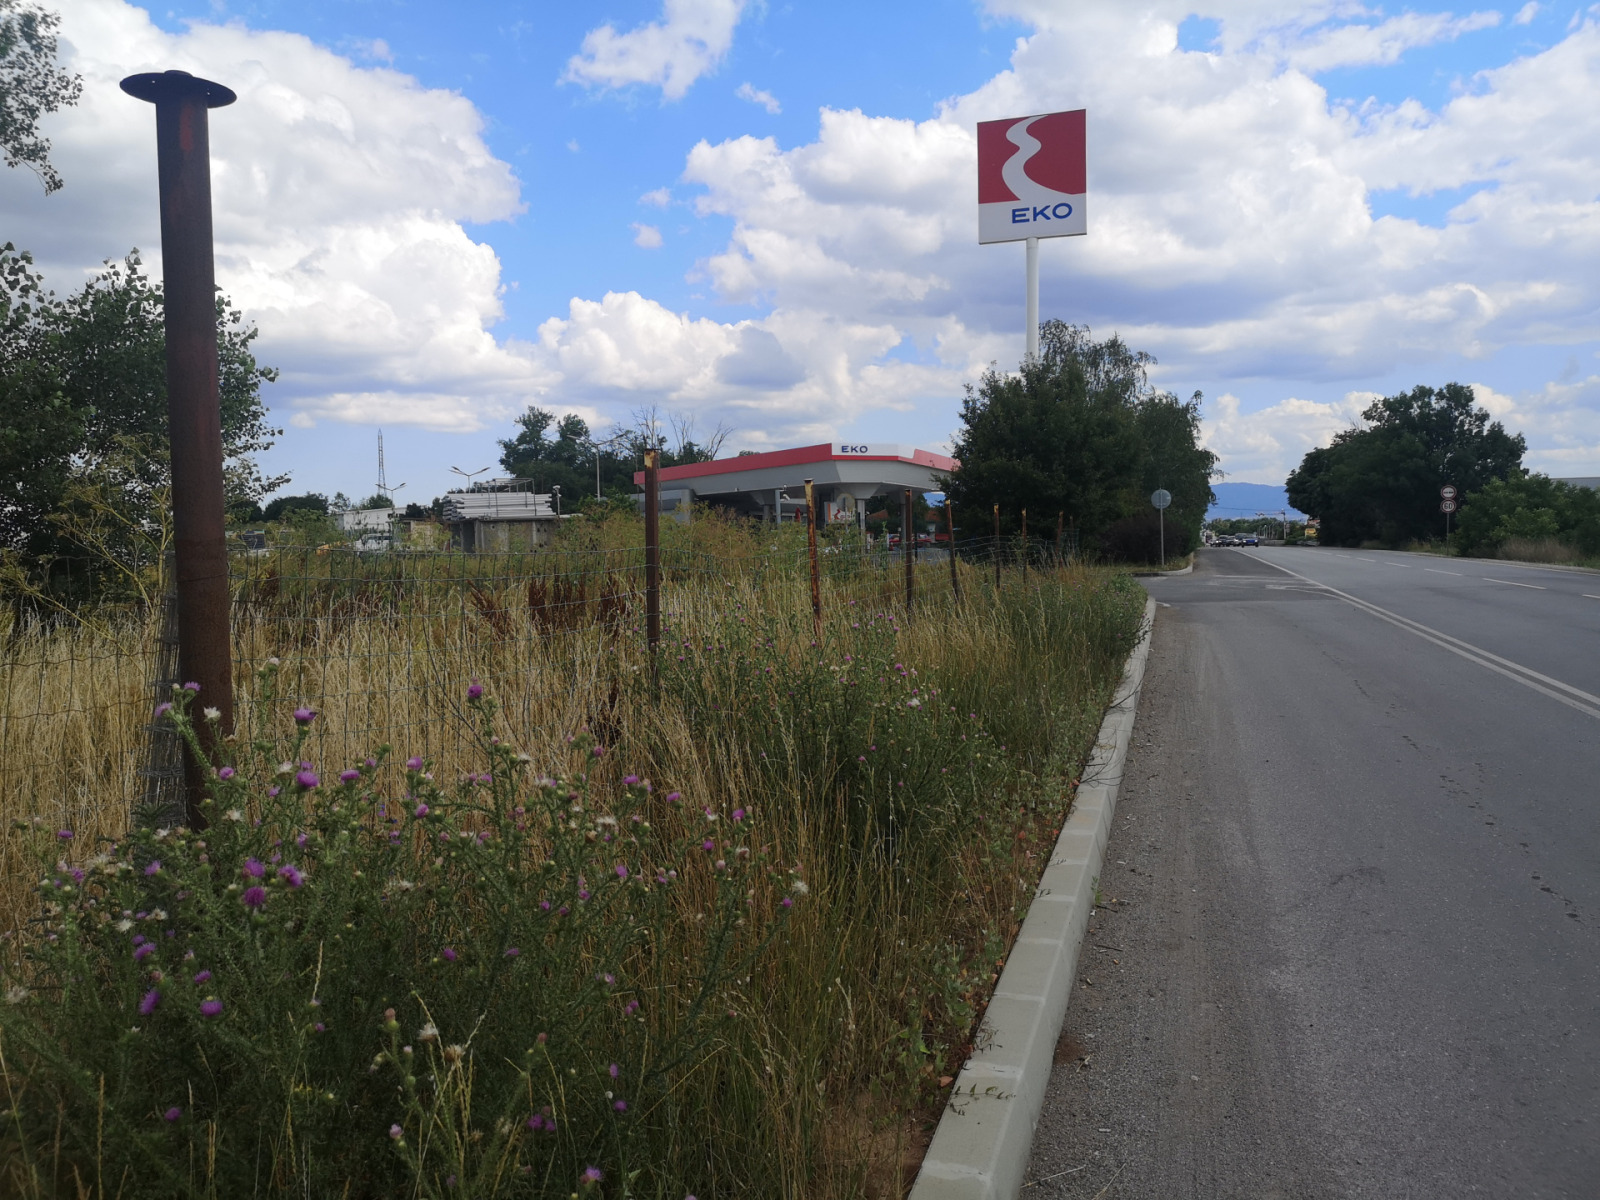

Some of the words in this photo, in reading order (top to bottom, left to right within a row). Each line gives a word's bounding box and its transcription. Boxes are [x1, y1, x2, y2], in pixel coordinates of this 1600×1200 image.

[1012, 203, 1072, 223] EKO
[841, 445, 868, 453] EKO
[1444, 502, 1453, 510] 60
